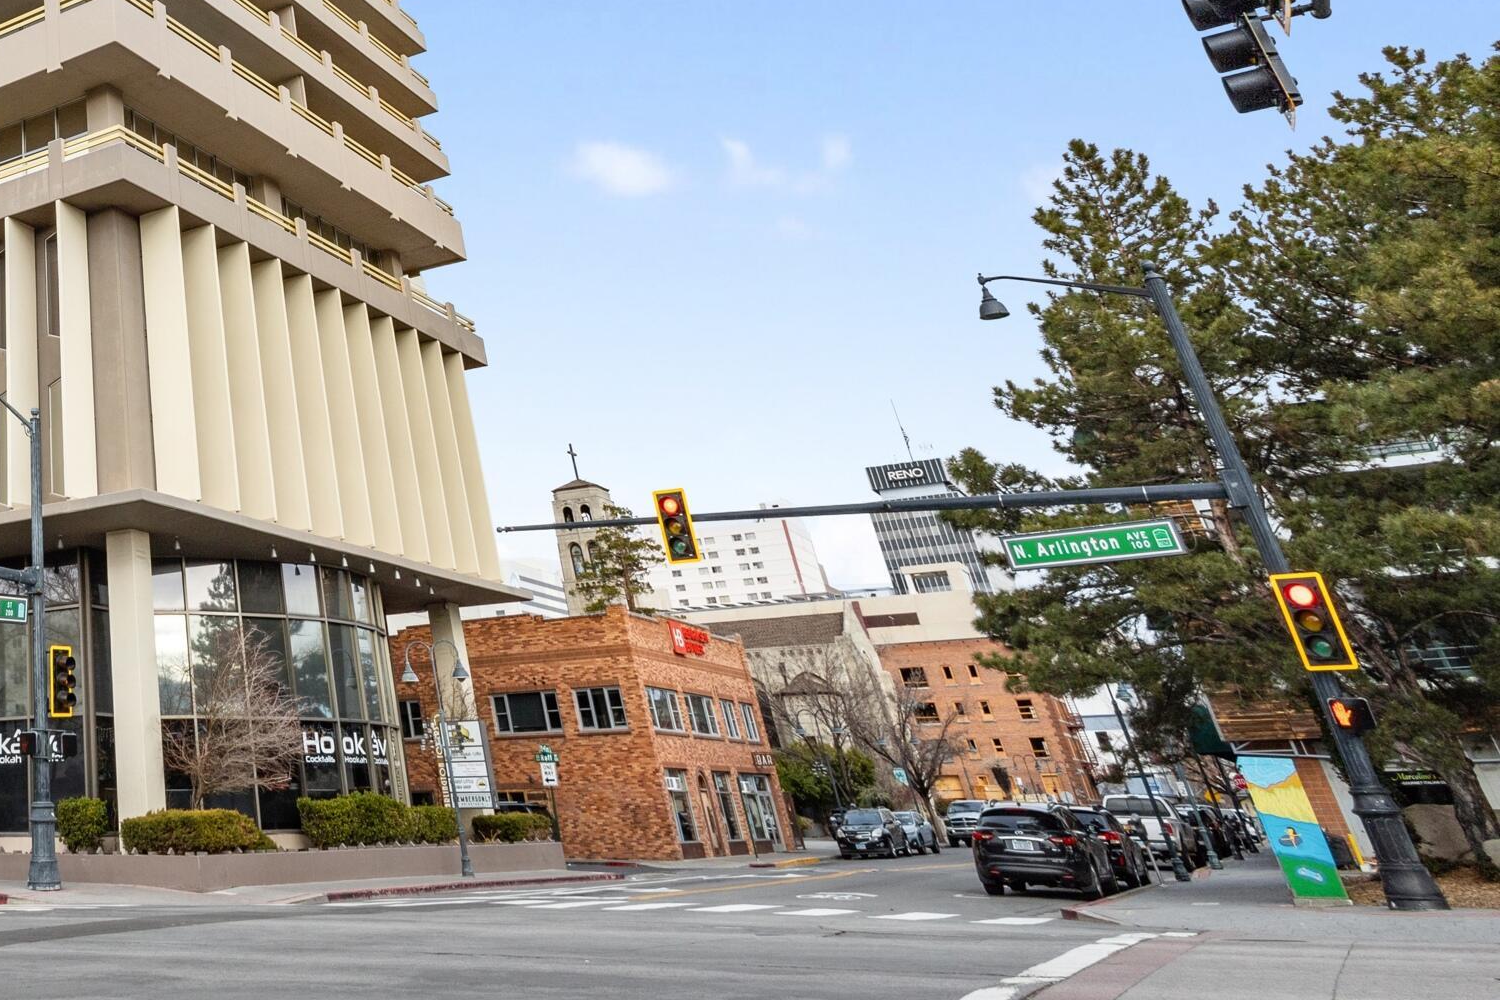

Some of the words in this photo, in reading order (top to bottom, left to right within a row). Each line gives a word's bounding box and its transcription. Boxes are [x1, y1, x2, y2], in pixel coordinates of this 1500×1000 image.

[887, 468, 924, 480] RENO
[1126, 530, 1149, 541] AVE
[1012, 544, 1032, 560] N.
[1037, 537, 1121, 557] Arlington
[1131, 540, 1151, 550] 100
[7, 601, 13, 609] ST
[305, 755, 336, 764] Cocktails
[344, 756, 368, 764] Hookah
[756, 754, 773, 766] BAR
